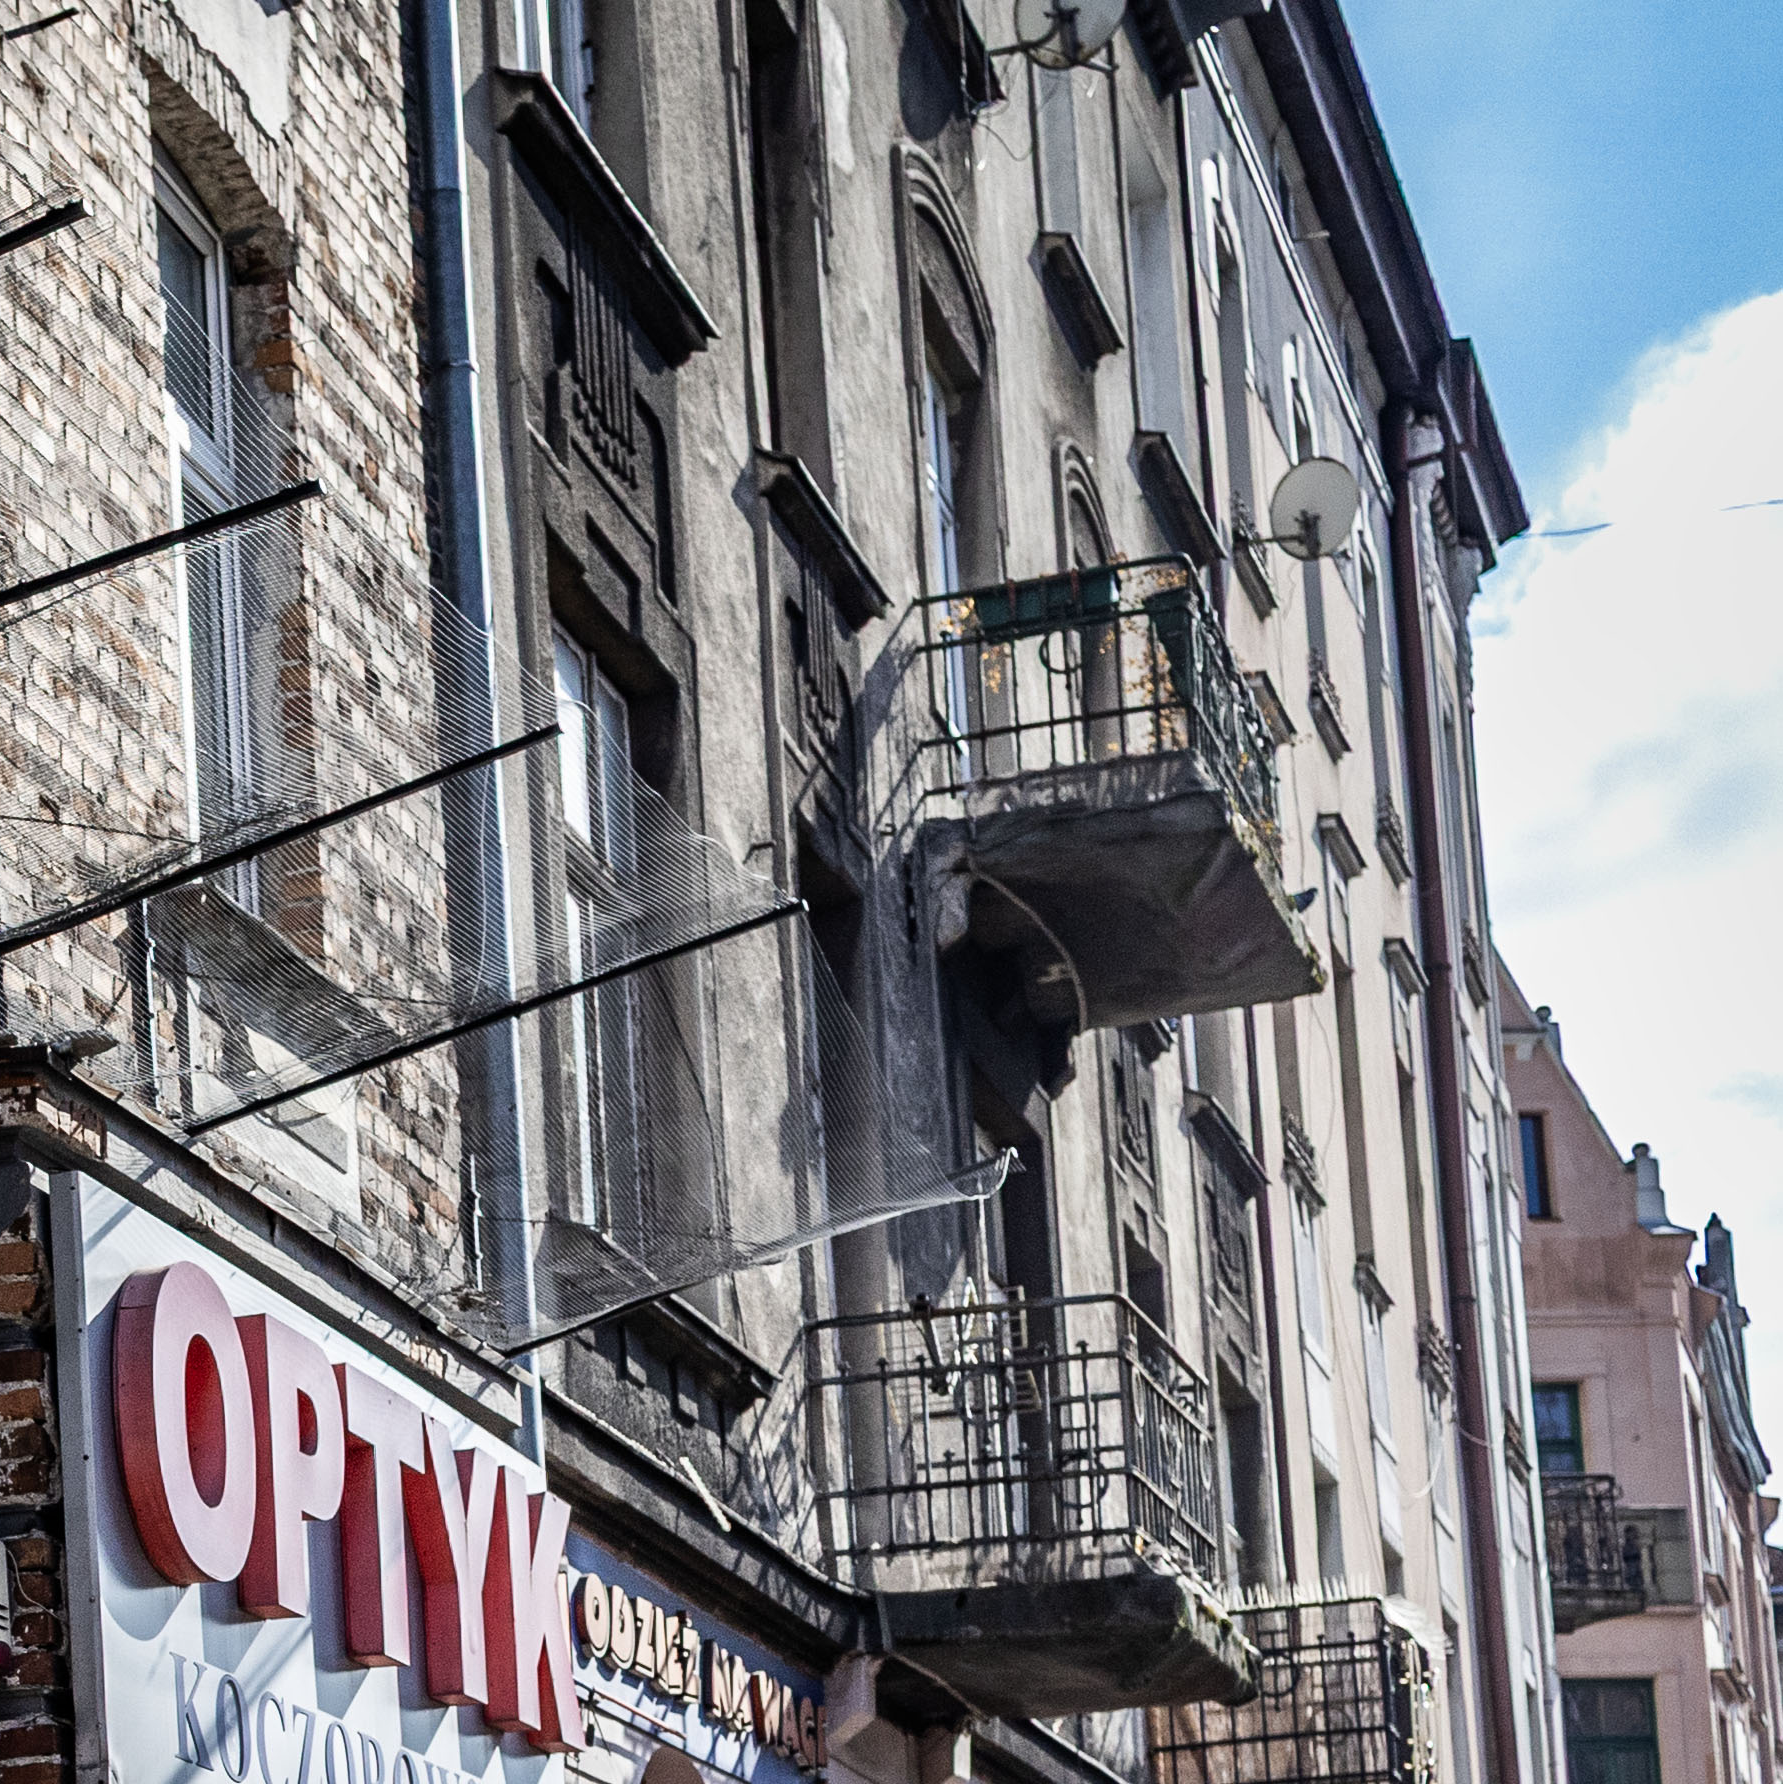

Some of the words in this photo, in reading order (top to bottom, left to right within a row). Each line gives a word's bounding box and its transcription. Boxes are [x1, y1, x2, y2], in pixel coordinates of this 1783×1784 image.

[113, 1260, 586, 1754] OPTYK
[574, 1573, 702, 1704] ODZIEŻ
[704, 1639, 753, 1733] NA
